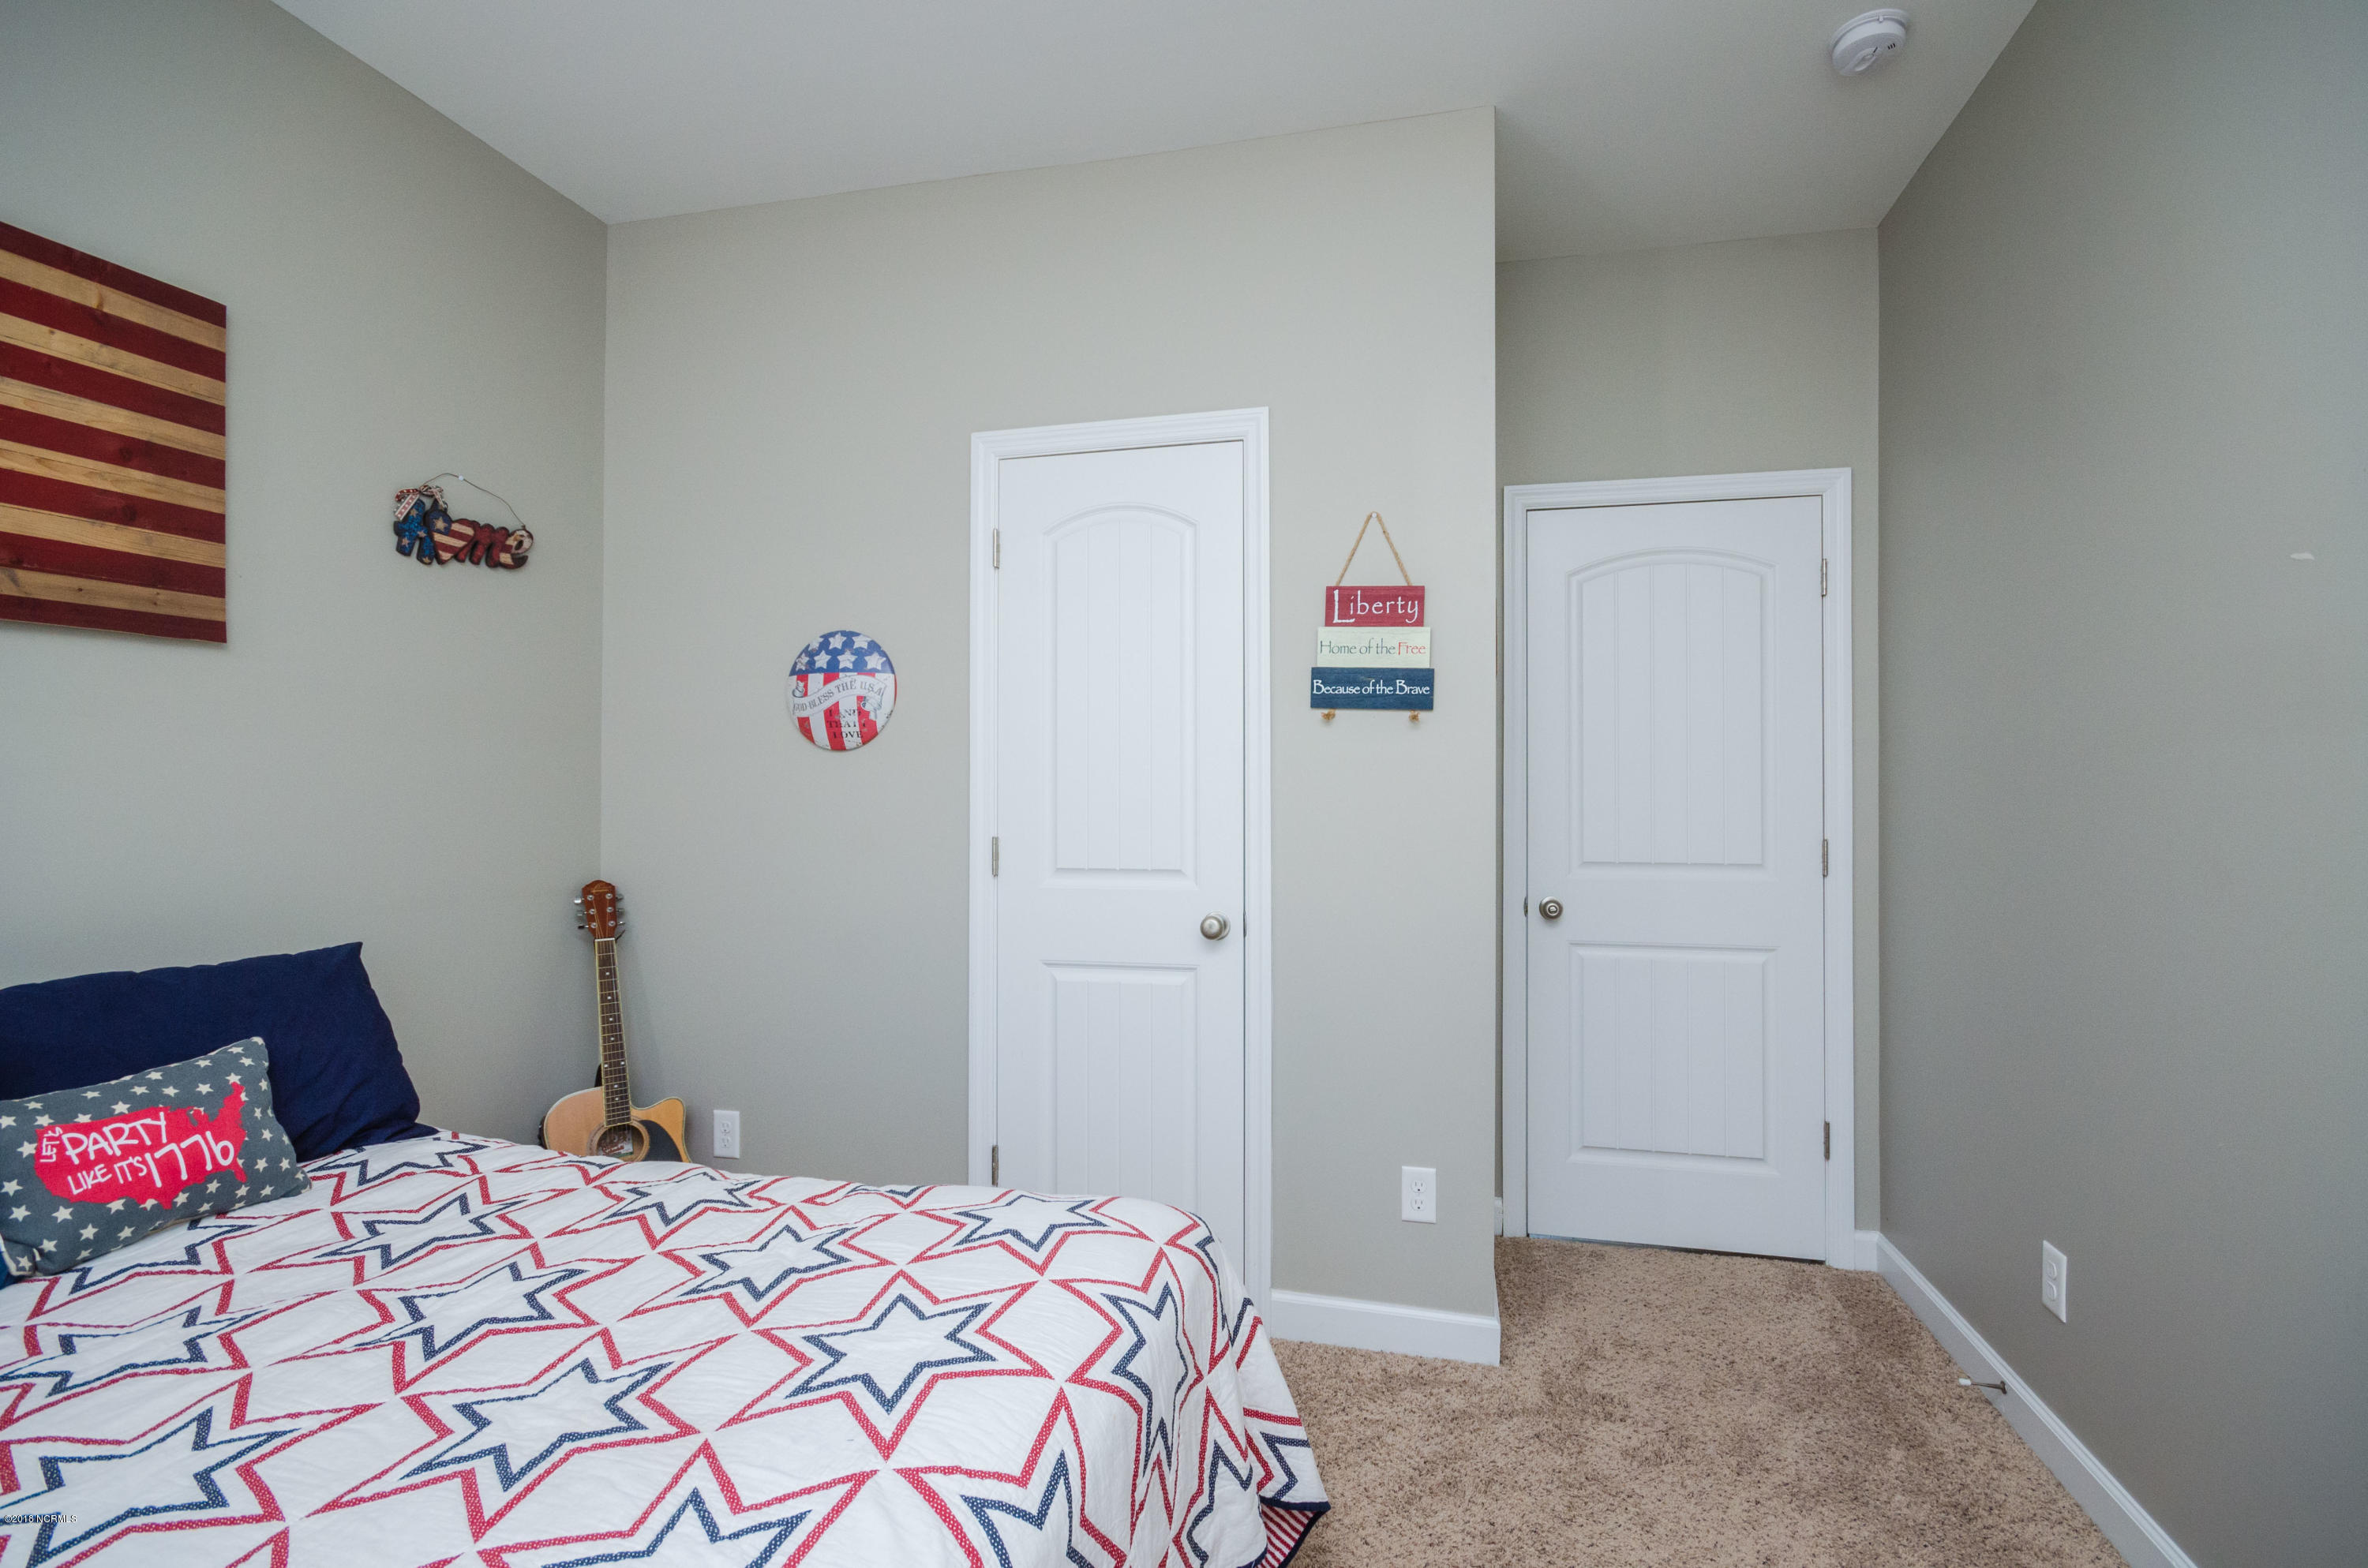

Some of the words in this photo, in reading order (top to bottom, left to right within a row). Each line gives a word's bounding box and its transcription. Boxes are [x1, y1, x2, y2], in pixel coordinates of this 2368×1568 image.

[1332, 589, 1418, 623] Liberty
[1320, 640, 1357, 654] Home
[1359, 638, 1374, 654] of
[1376, 638, 1396, 654] the
[1398, 642, 1426, 655] Free
[808, 689, 834, 709] BLESS
[835, 679, 856, 693] THE
[1313, 679, 1360, 694] Because
[1362, 679, 1375, 694] of
[1376, 679, 1393, 694] the
[1396, 679, 1430, 694] Brave
[39, 1126, 63, 1162] LET'S
[62, 1111, 166, 1165] PARTY
[67, 1163, 112, 1195] LIKE
[114, 1156, 147, 1184] IT'S
[144, 1131, 234, 1188] 1776
